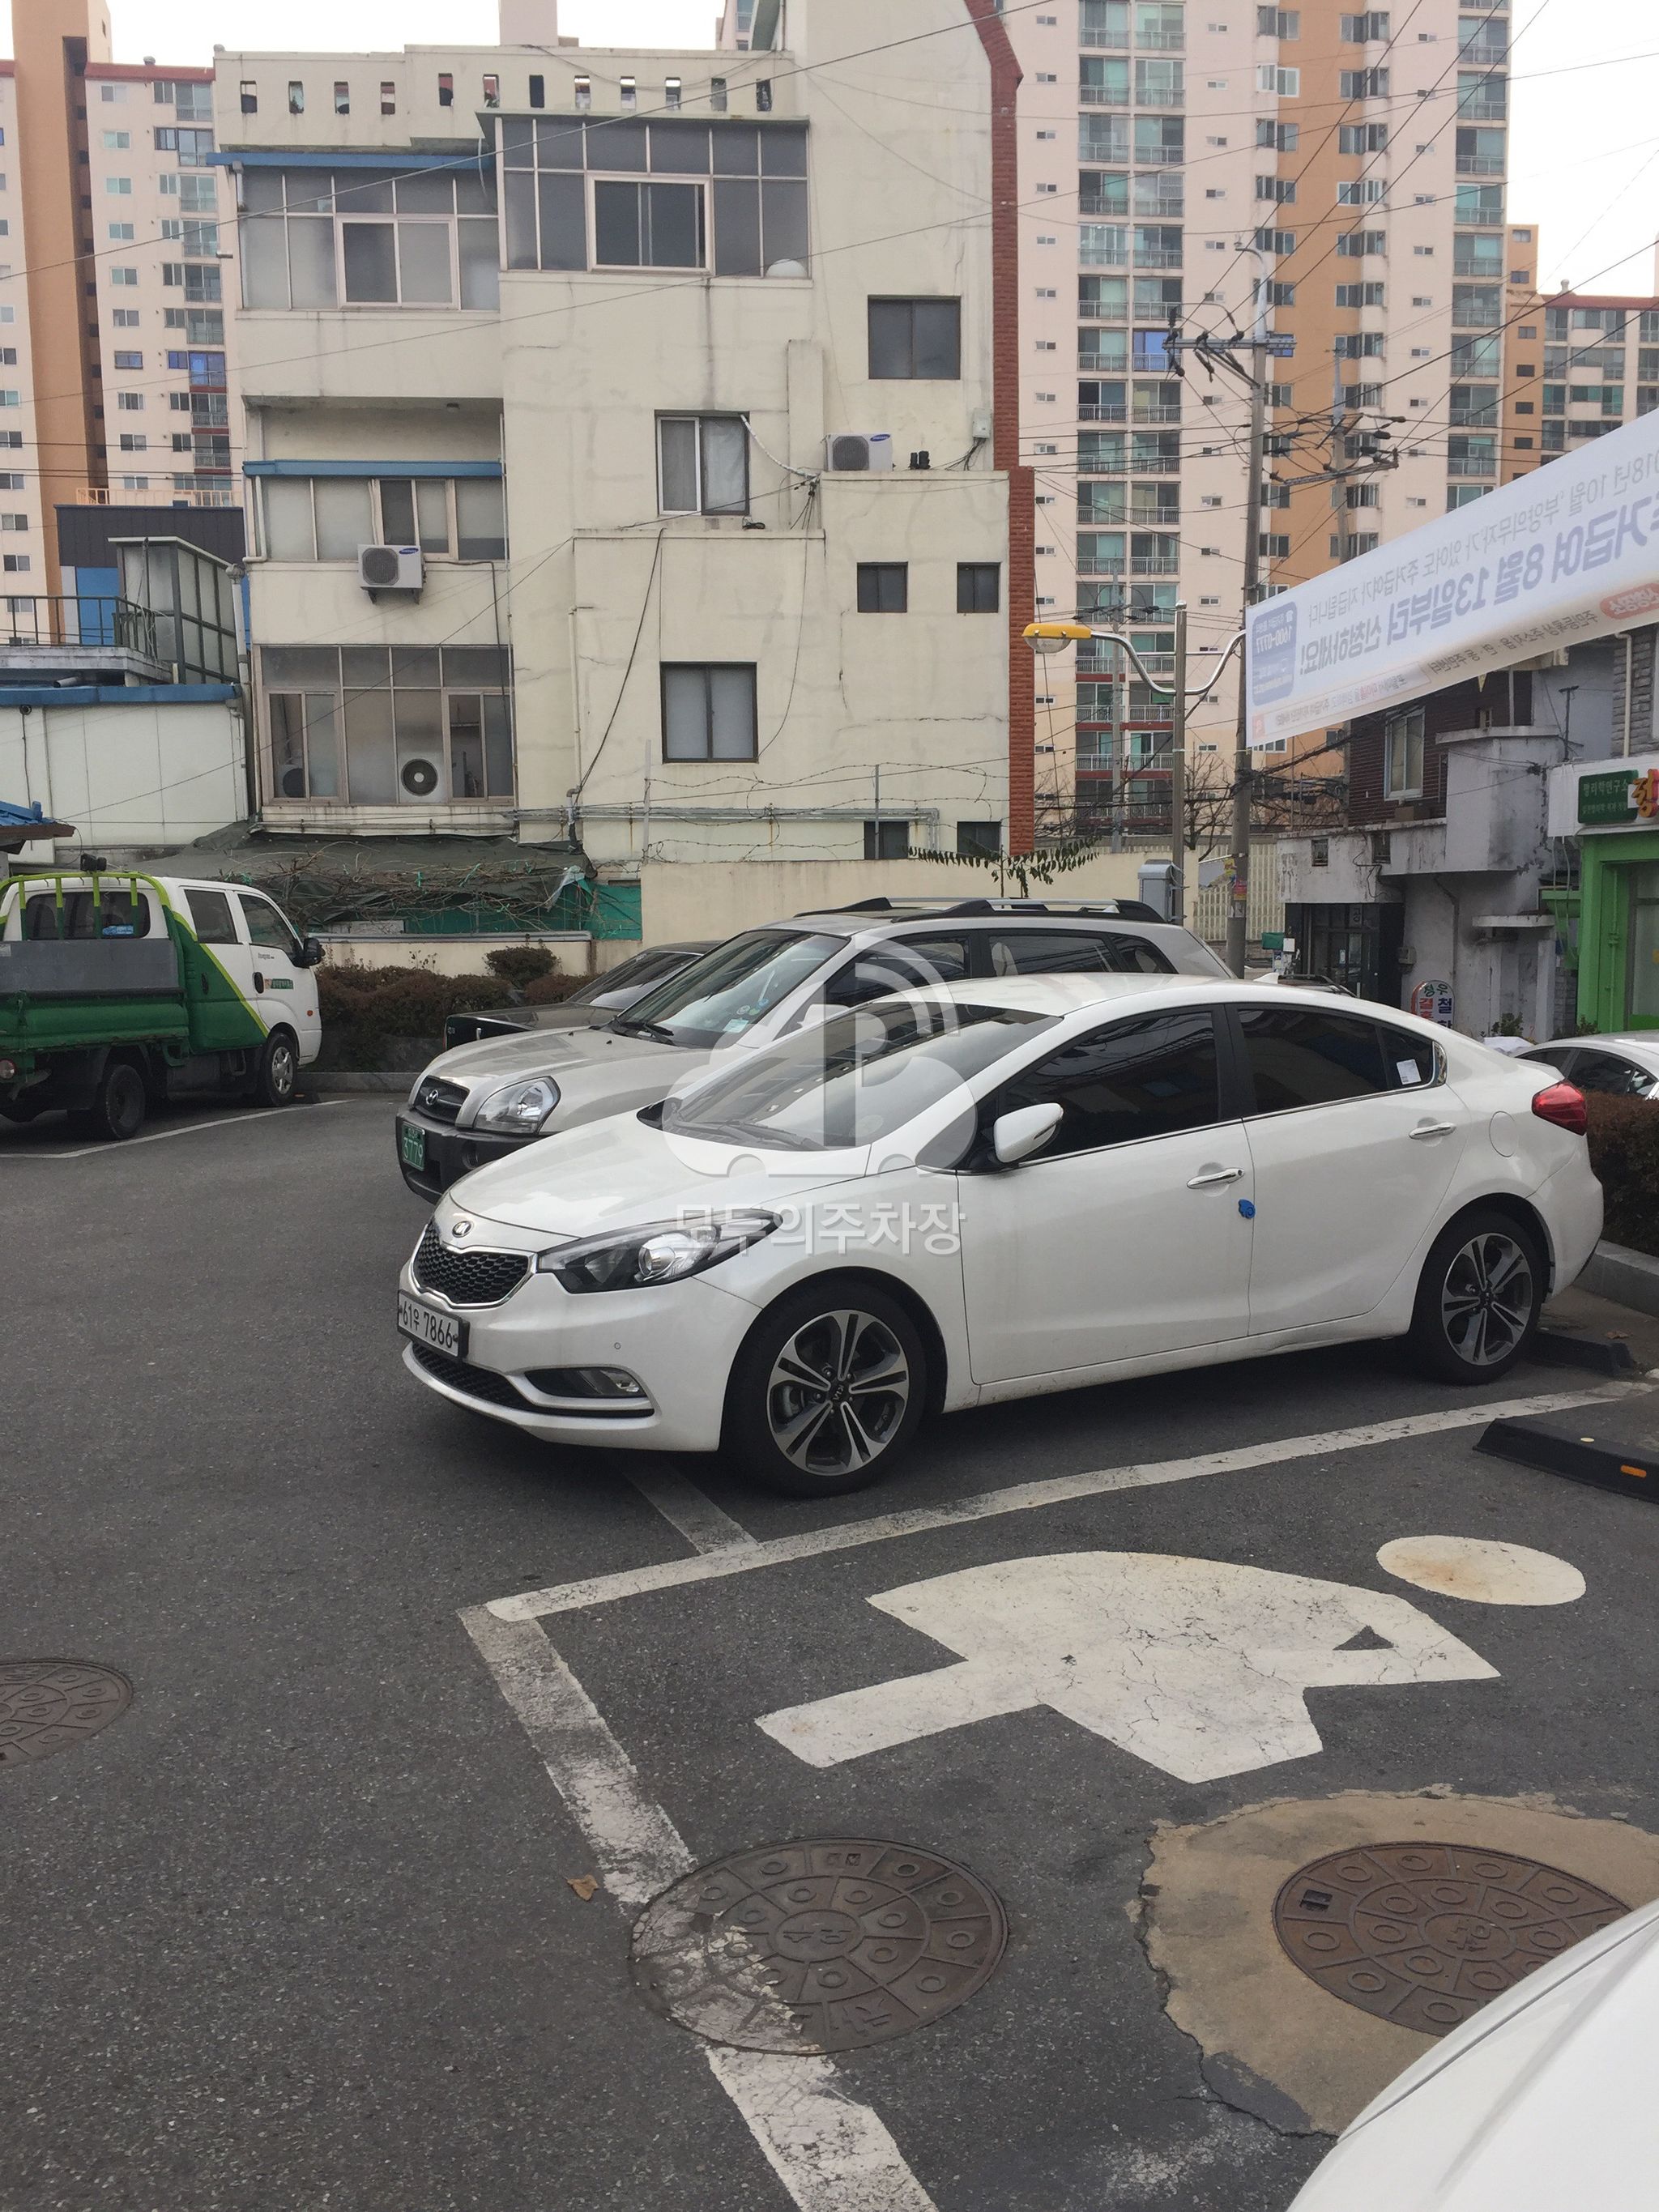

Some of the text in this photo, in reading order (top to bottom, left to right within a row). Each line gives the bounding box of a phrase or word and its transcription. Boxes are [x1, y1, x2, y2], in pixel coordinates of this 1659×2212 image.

[403, 1136, 424, 1166] 3779
[403, 1300, 453, 1349] 61우 7866
